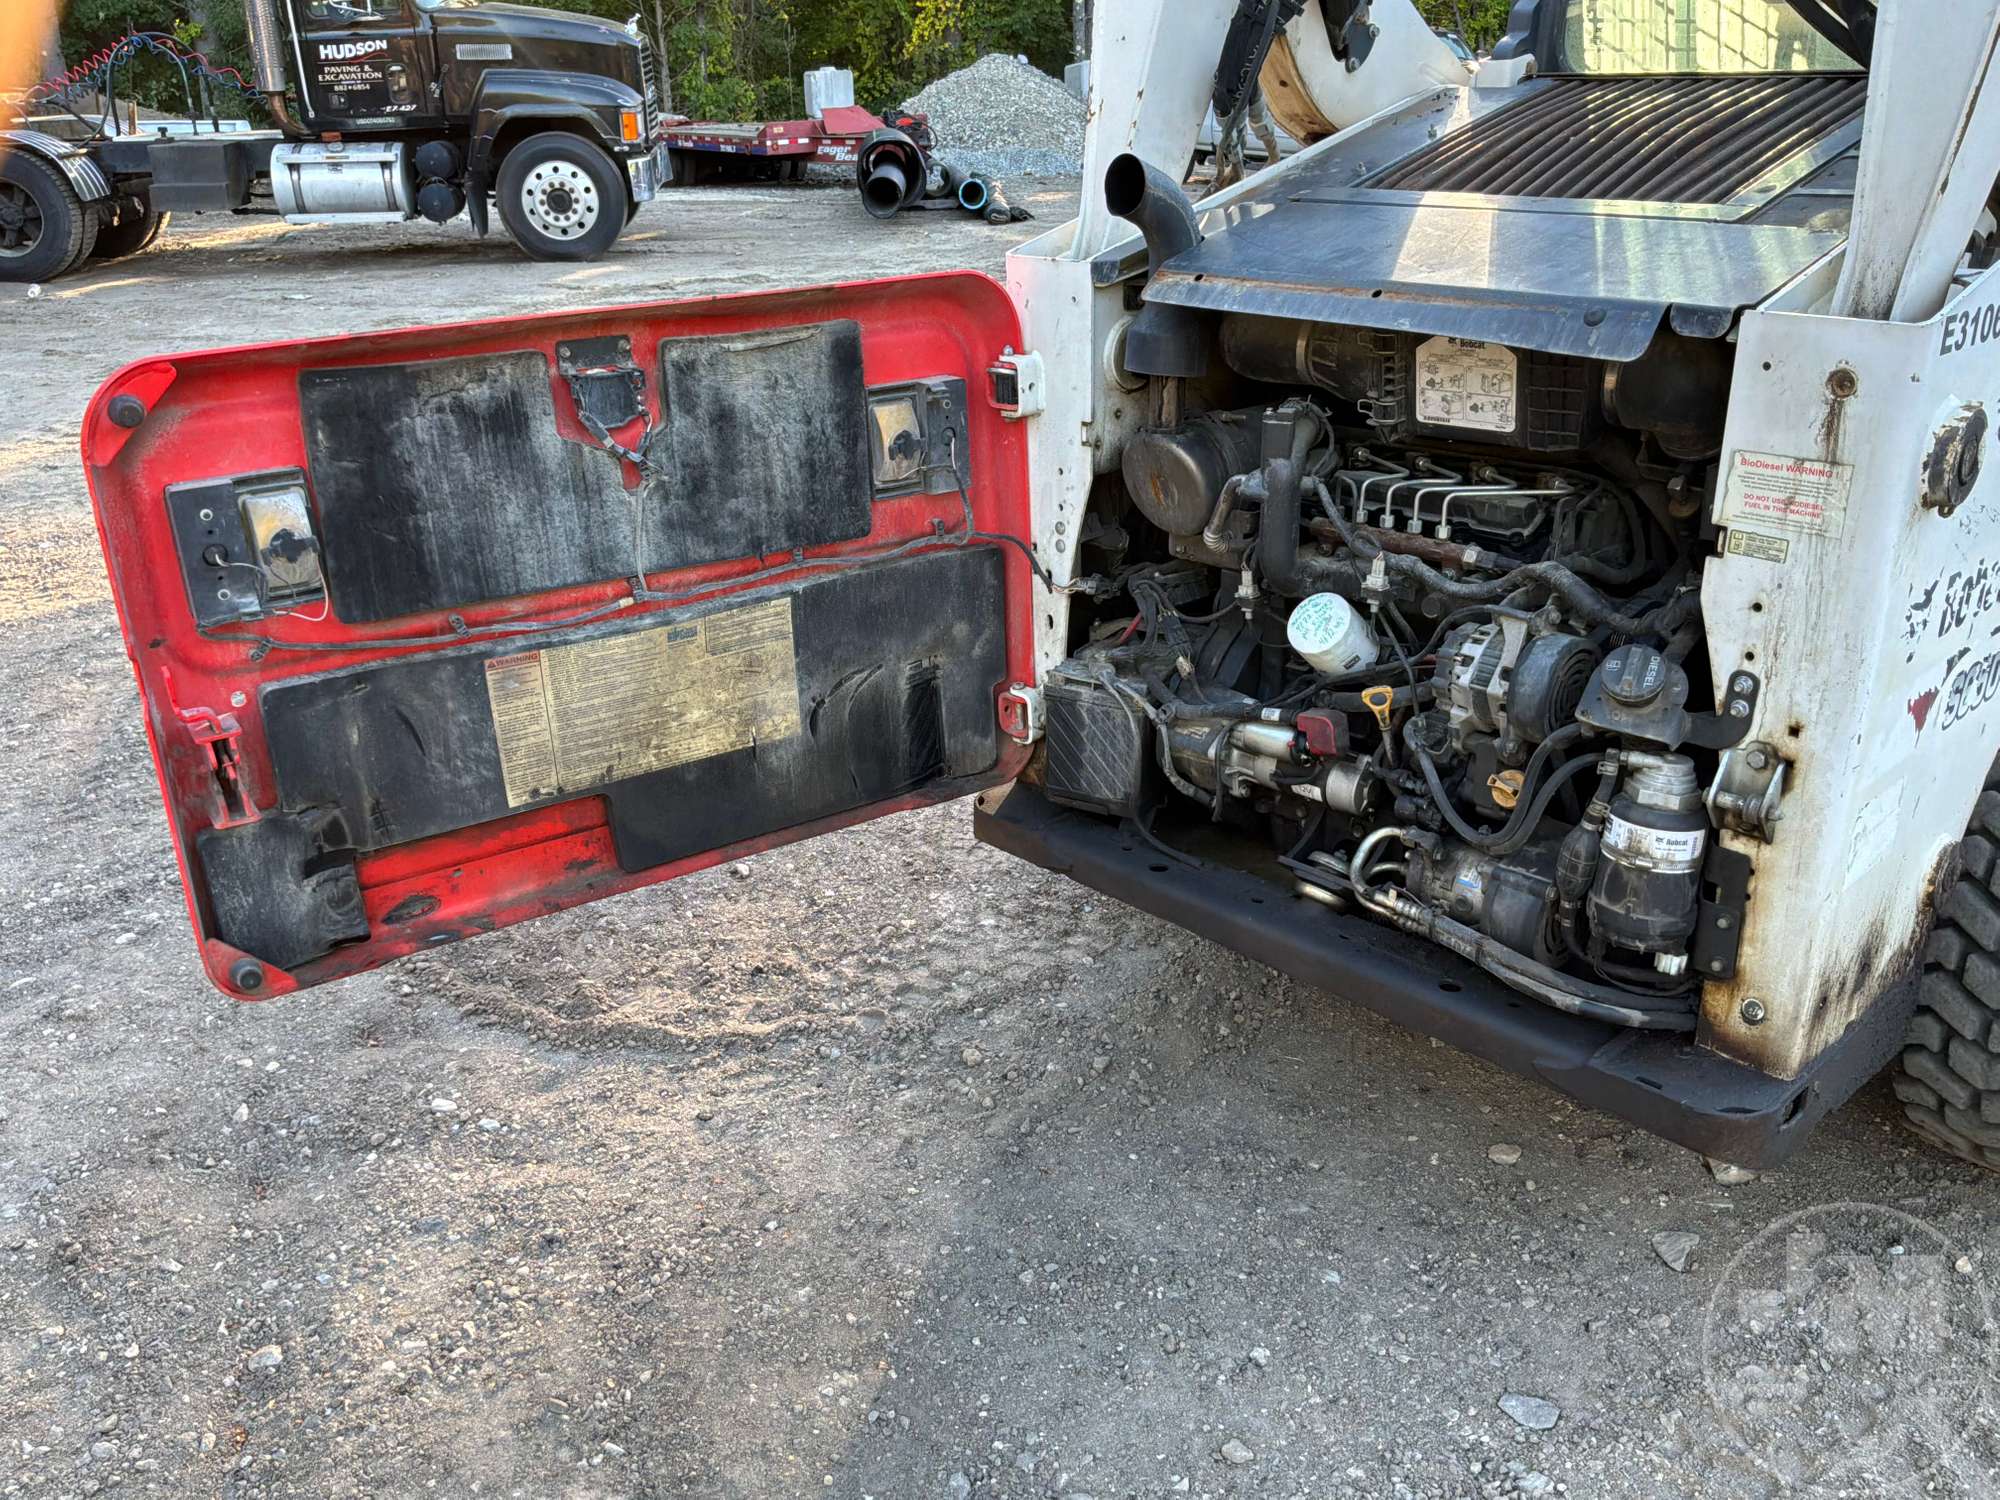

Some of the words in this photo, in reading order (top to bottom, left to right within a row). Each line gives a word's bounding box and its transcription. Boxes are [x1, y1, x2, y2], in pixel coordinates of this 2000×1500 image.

[319, 39, 388, 60] HUDSON
[324, 65, 361, 74] PAVING
[363, 64, 373, 72] &
[318, 71, 383, 82] EXCAVATION
[816, 145, 852, 156] Eager
[835, 152, 859, 161] Bea
[1740, 457, 1784, 471] BioDiesel
[1786, 463, 1834, 479] WARNING
[1743, 492, 1755, 500] DO
[1755, 494, 1770, 503] NOT
[1744, 500, 1761, 510] FUEL
[1772, 505, 1788, 513] THIS
[1788, 508, 1821, 519] MACHINE
[496, 653, 538, 667] WARNING
[1643, 656, 1661, 689] DIESEL
